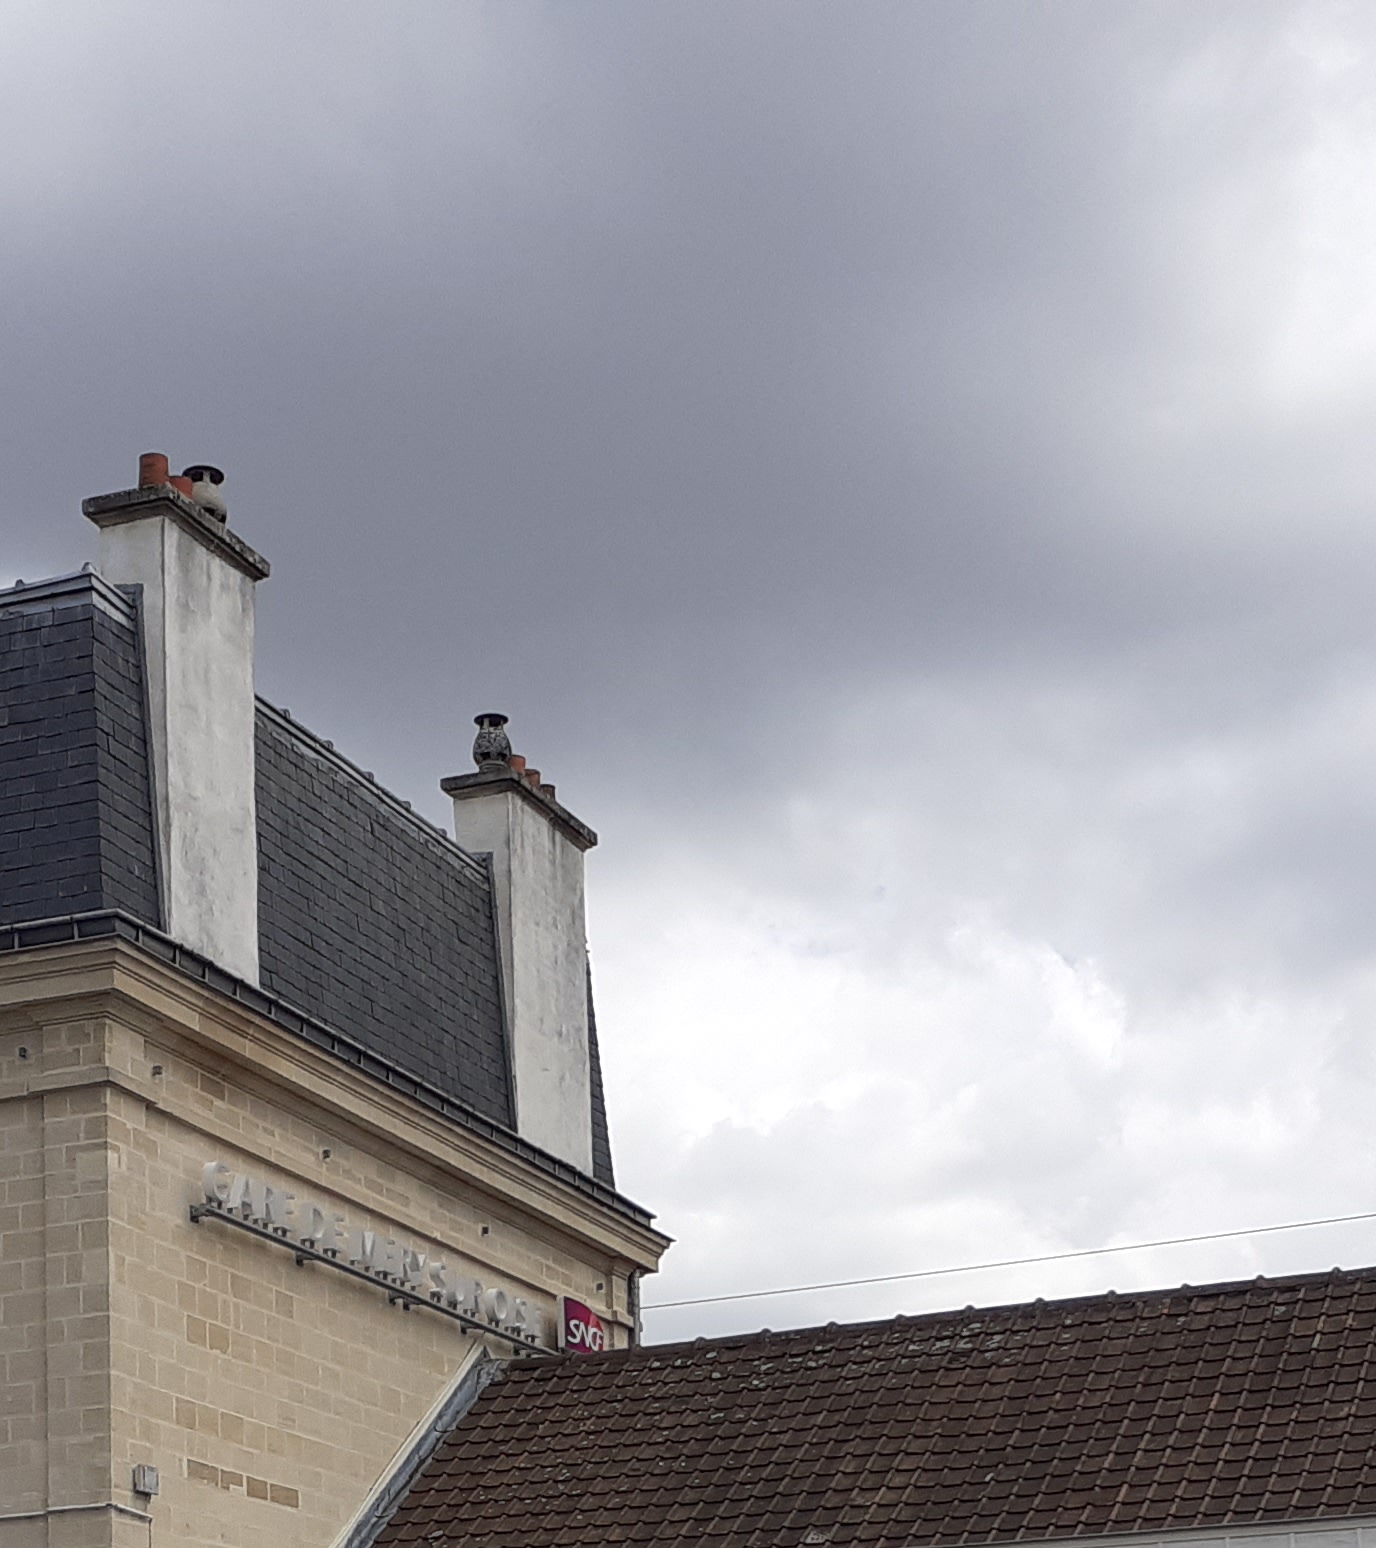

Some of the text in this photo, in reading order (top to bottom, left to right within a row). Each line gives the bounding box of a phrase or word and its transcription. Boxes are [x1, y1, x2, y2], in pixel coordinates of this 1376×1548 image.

[202, 1161, 296, 1231] GARE
[299, 1203, 345, 1253] DE
[429, 1261, 484, 1313] SUR
[567, 1319, 604, 1351] SNCF
